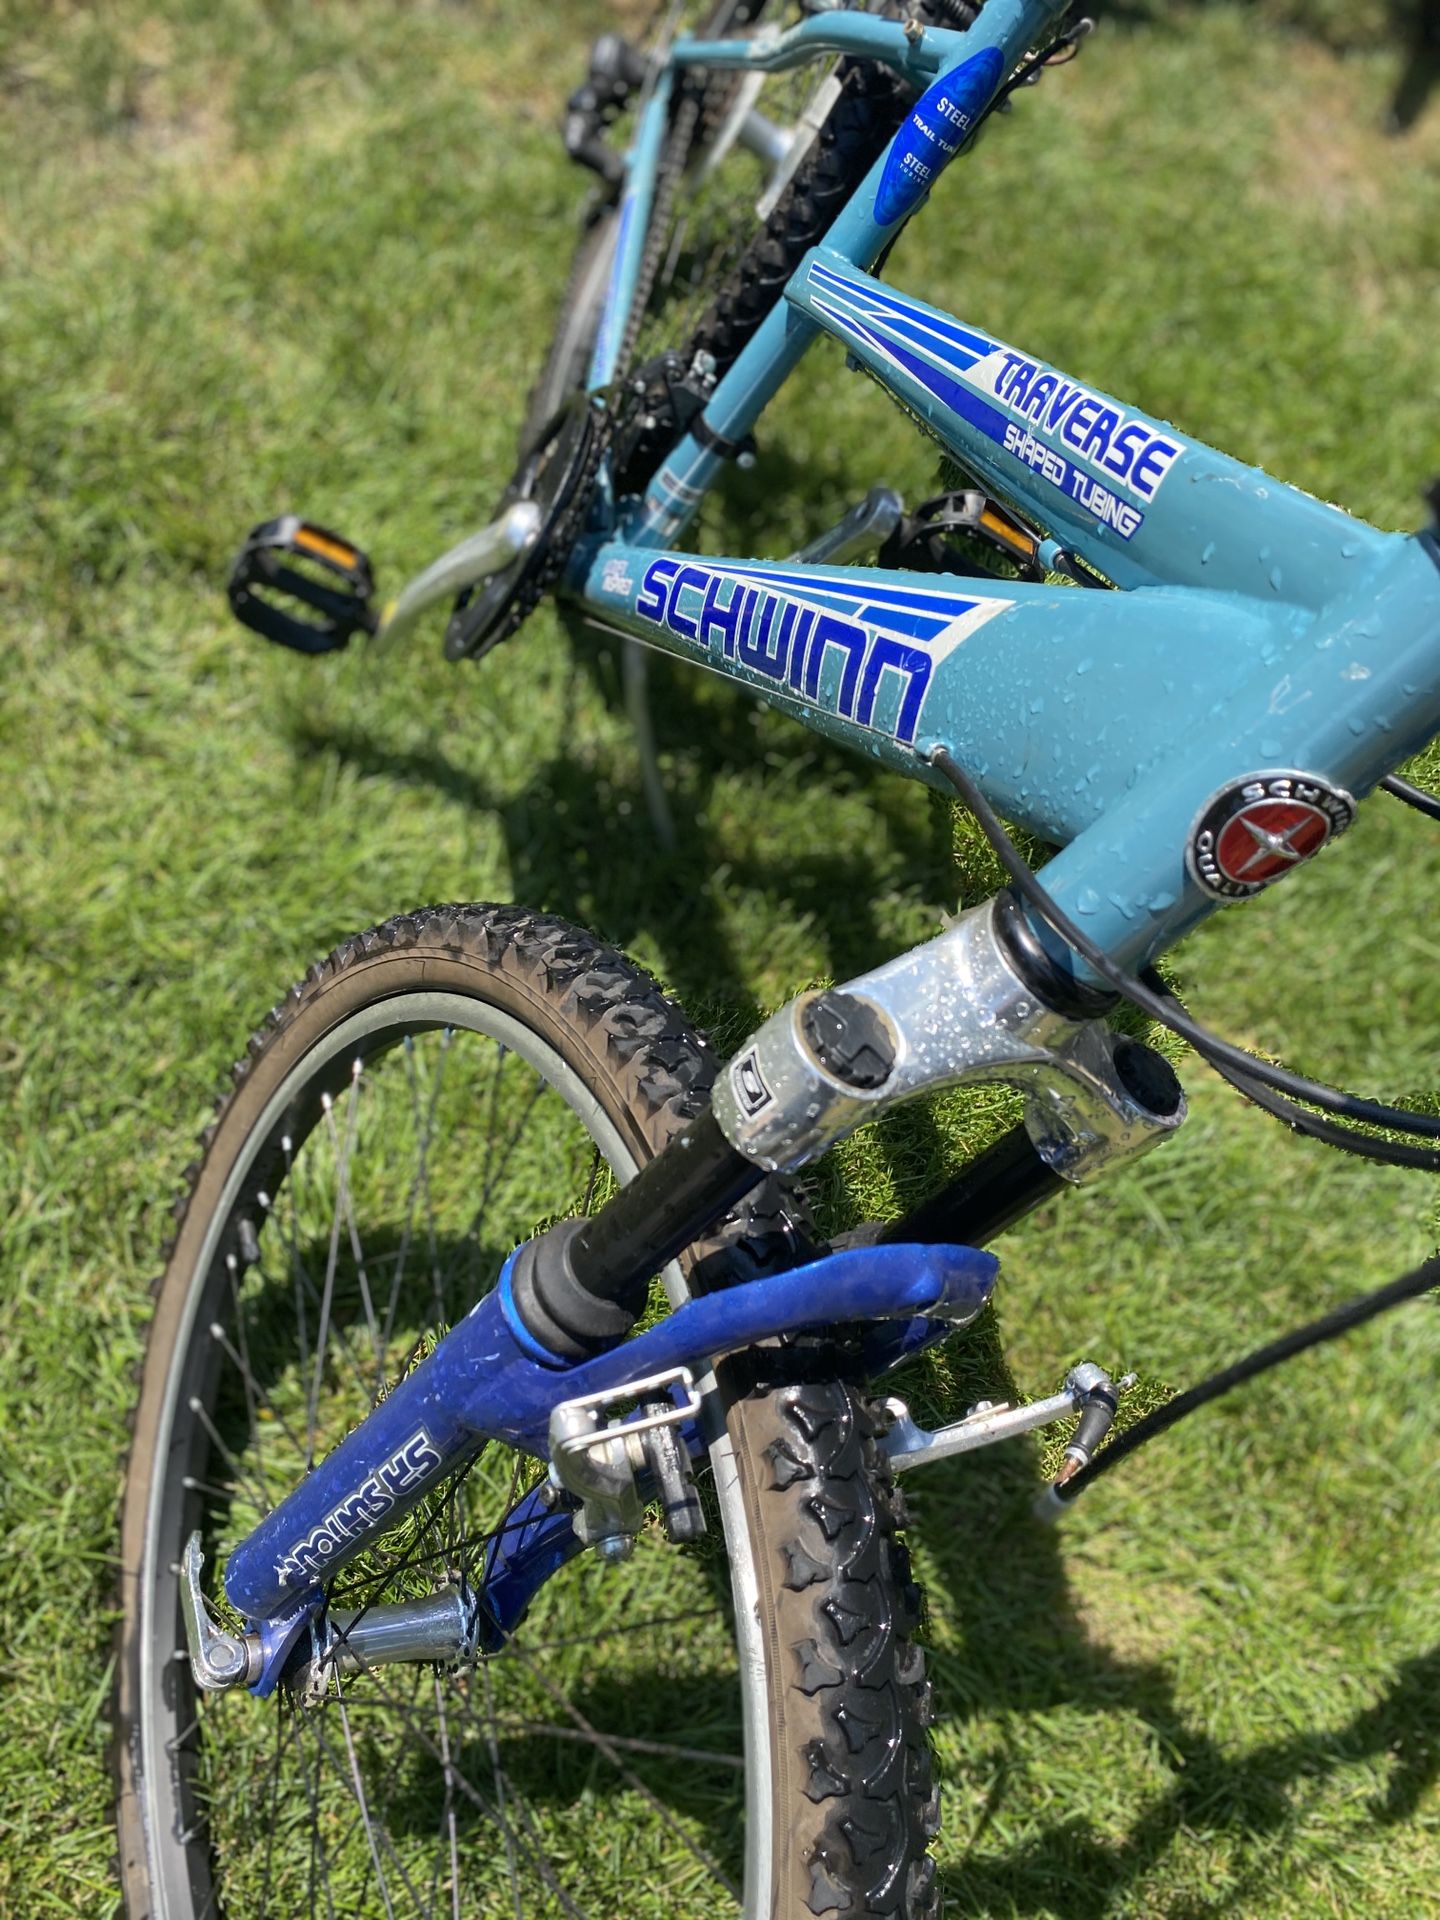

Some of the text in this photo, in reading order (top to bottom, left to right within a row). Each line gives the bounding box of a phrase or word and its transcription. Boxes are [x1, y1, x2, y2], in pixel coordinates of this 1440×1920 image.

[912, 114, 936, 141] TRAIL
[936, 96, 970, 130] STEEL
[904, 152, 931, 179] STEEL
[994, 351, 1182, 499] TRAVERSE
[1002, 422, 1143, 538] SHAPED TUBING
[636, 556, 934, 750] SCHWINN
[378, 1431, 442, 1496] SR
